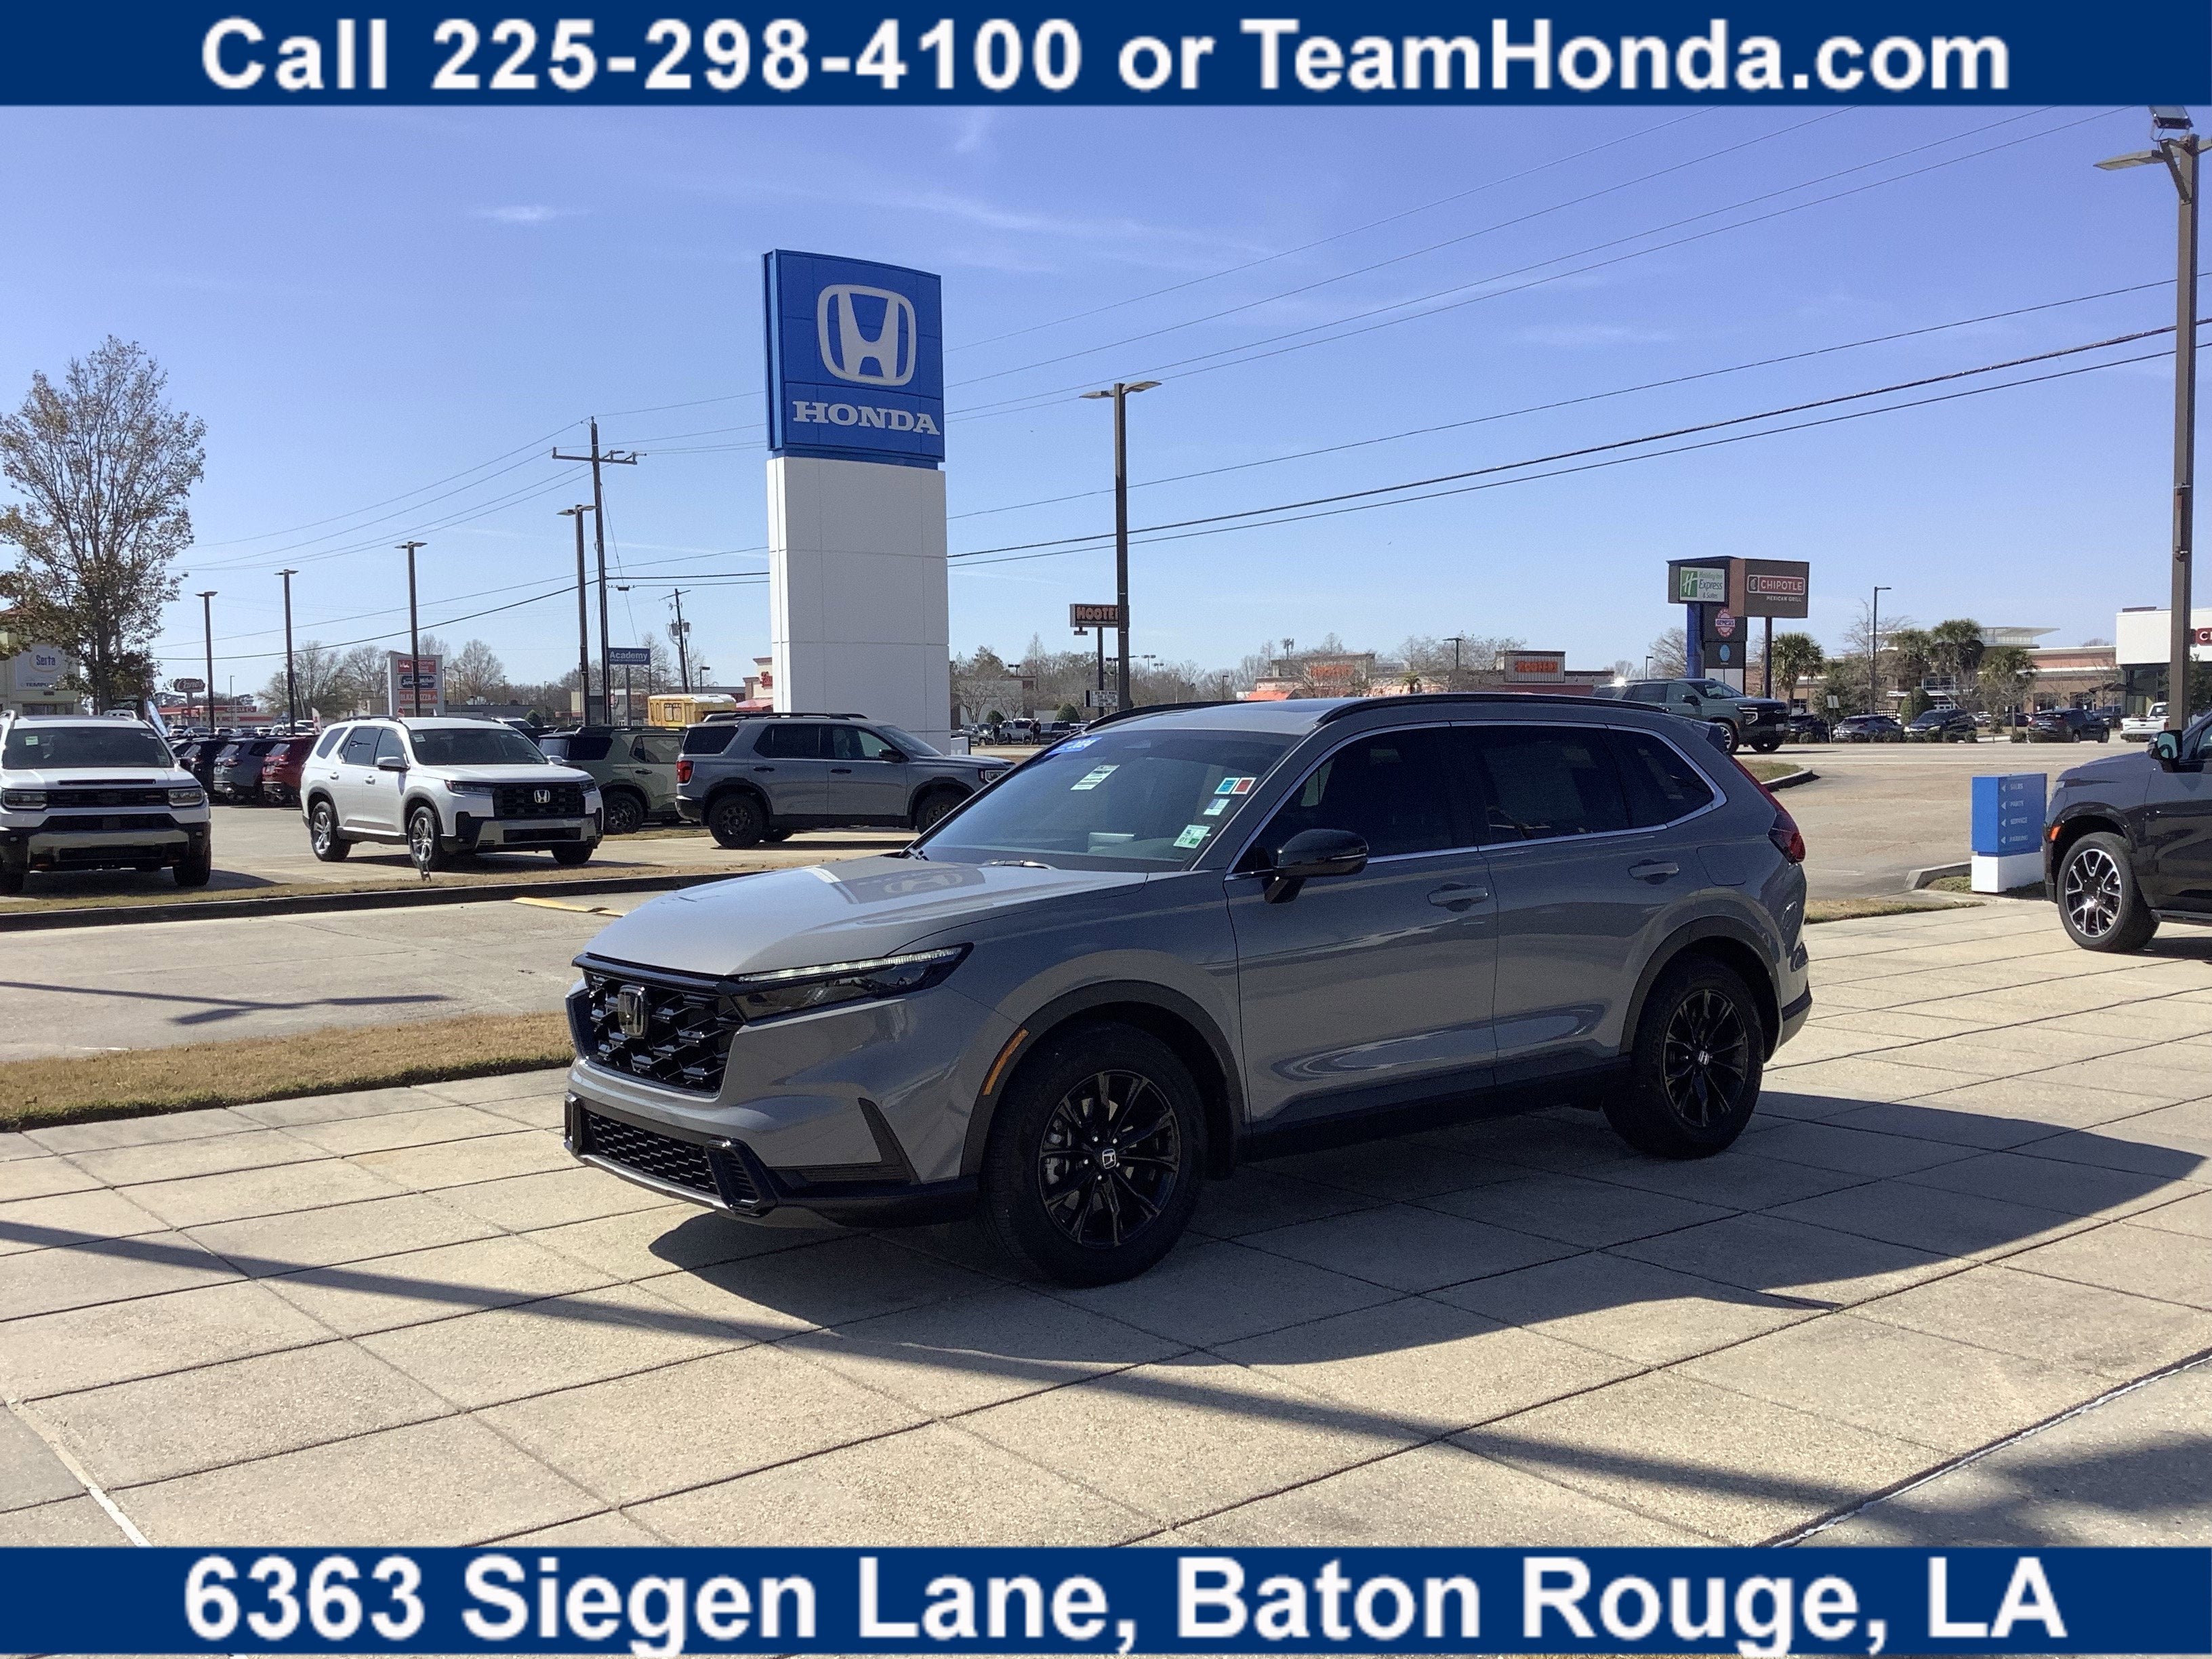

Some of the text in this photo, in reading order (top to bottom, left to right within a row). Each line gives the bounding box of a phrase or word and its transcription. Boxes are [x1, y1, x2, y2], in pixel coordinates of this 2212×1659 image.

[792, 401, 941, 436] HONDA
[1699, 579, 1723, 591] Express
[1760, 579, 1803, 592] CHIPOTLE
[1076, 607, 1118, 620] HOOTE
[36, 655, 56, 665] Serta
[609, 651, 648, 661] Academy
